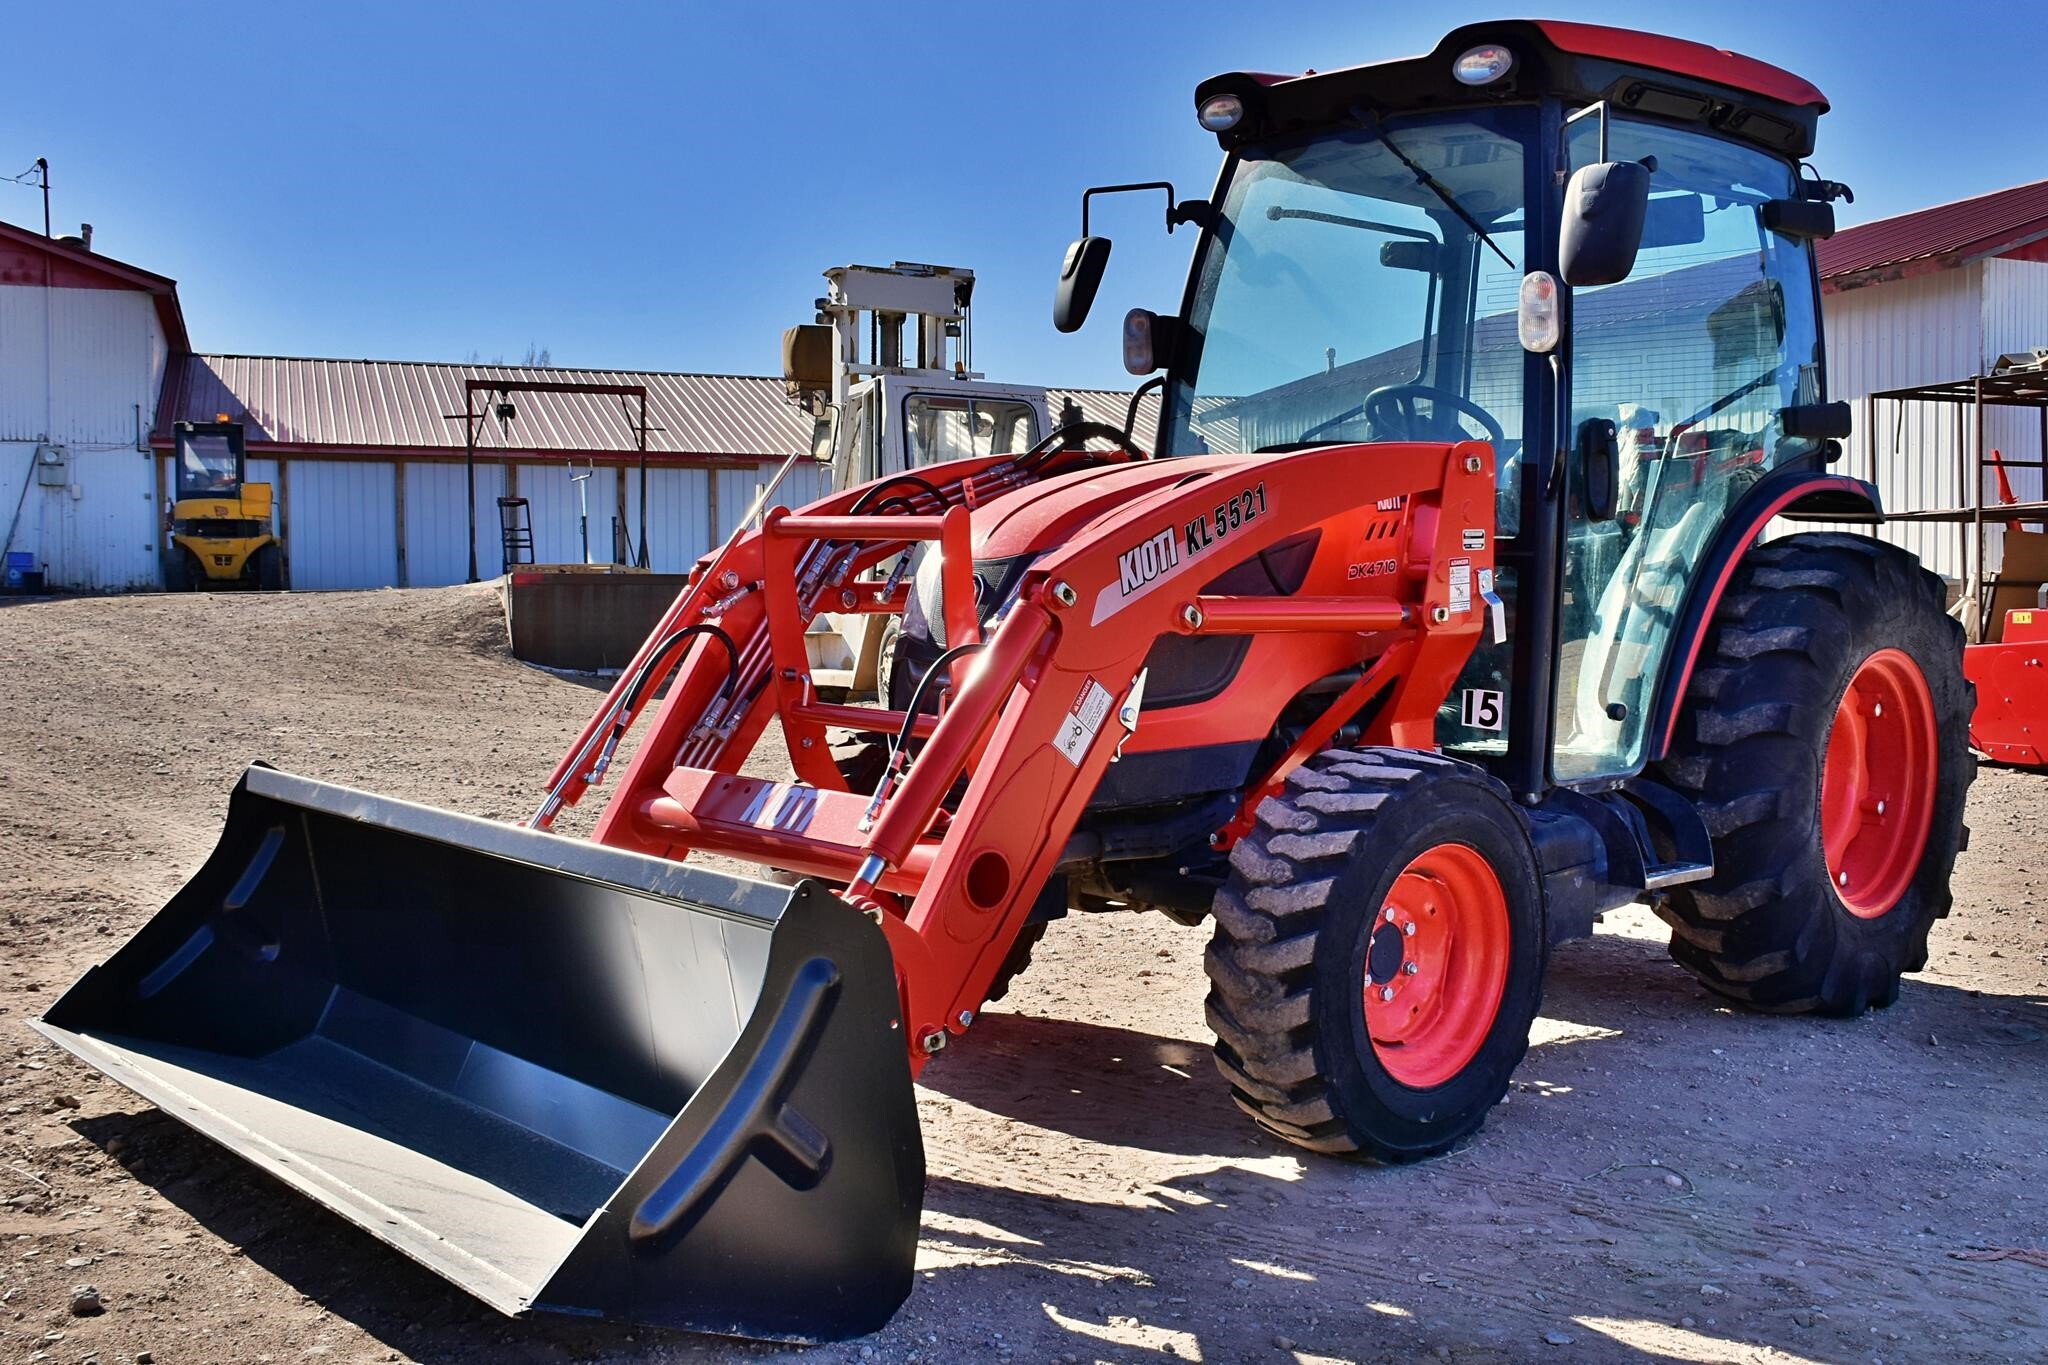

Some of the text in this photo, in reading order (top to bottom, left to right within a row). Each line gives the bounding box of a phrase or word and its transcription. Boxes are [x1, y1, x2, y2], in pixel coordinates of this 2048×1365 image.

[1118, 526, 1179, 597] KIOTI
[1347, 559, 1398, 580] DK4710
[1076, 680, 1093, 706] DANGER
[1464, 690, 1499, 728] 15
